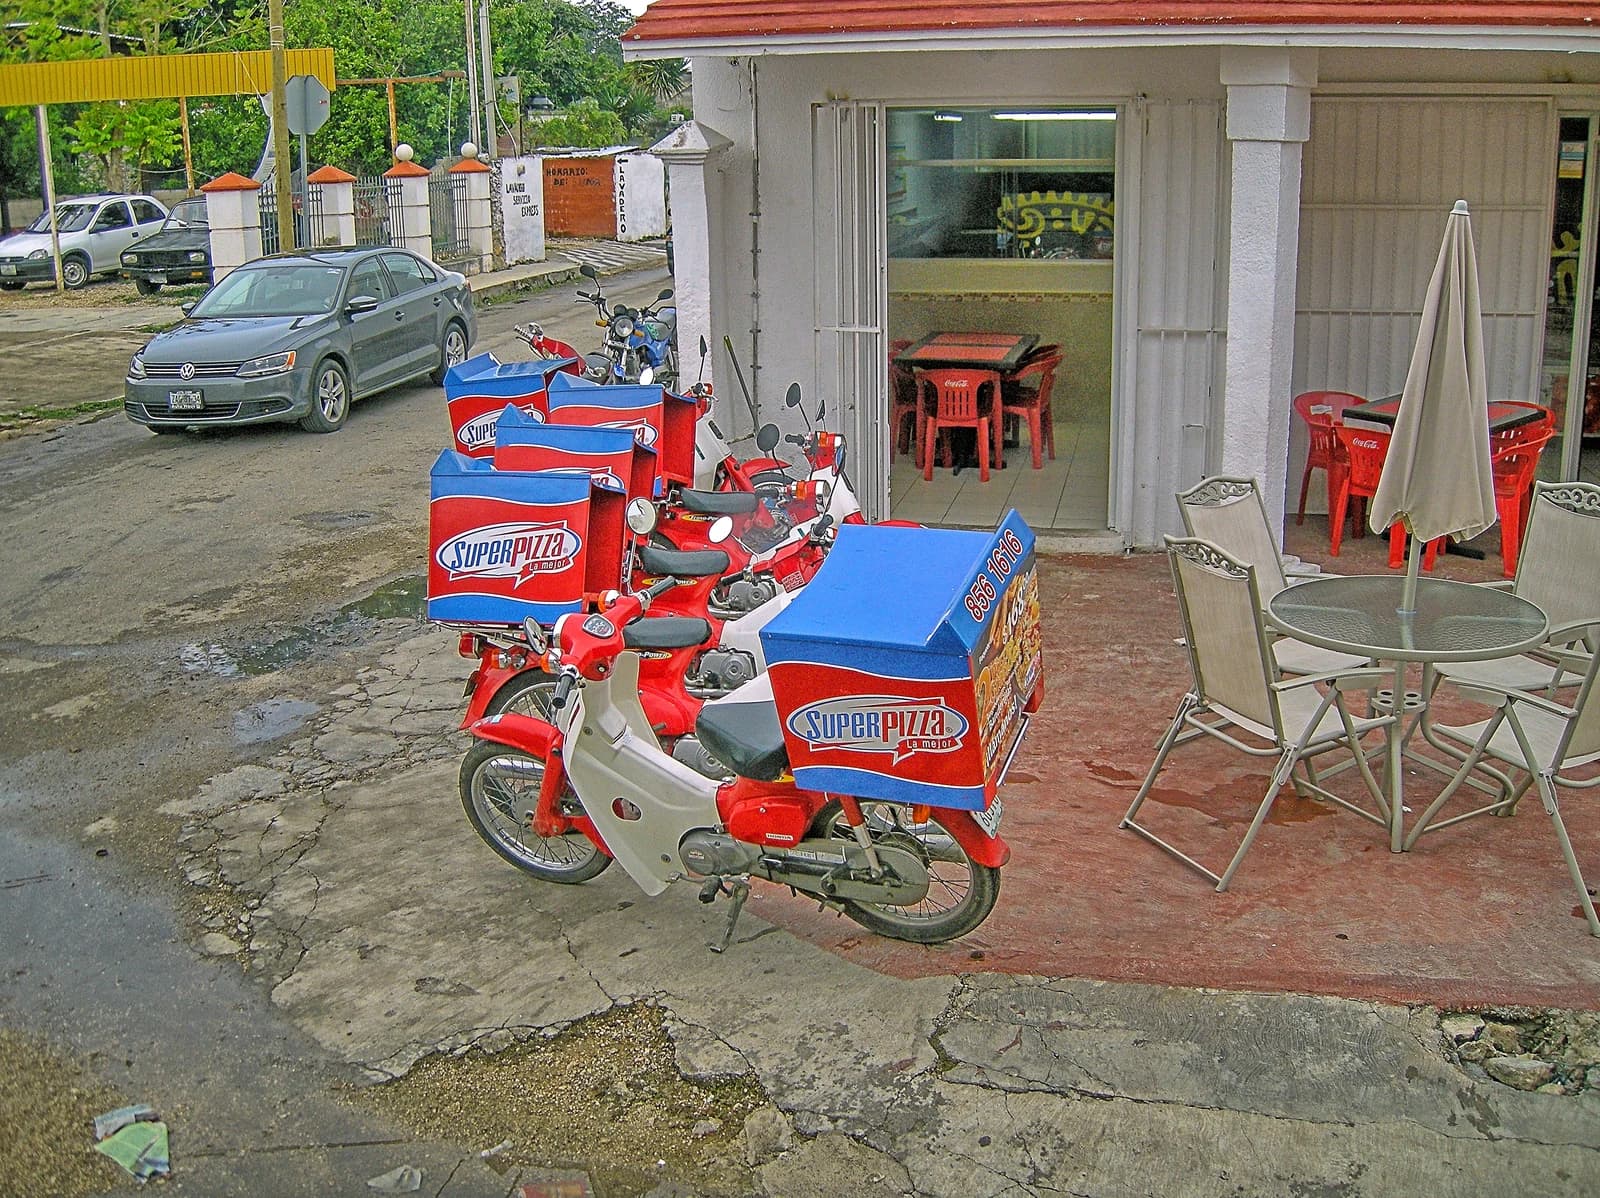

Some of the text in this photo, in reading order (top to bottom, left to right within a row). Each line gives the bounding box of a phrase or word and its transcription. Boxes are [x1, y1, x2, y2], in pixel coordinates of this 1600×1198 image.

[618, 165, 627, 234] LAVADERO
[964, 528, 1023, 622] 856 1616
[922, 739, 952, 750] mejor
